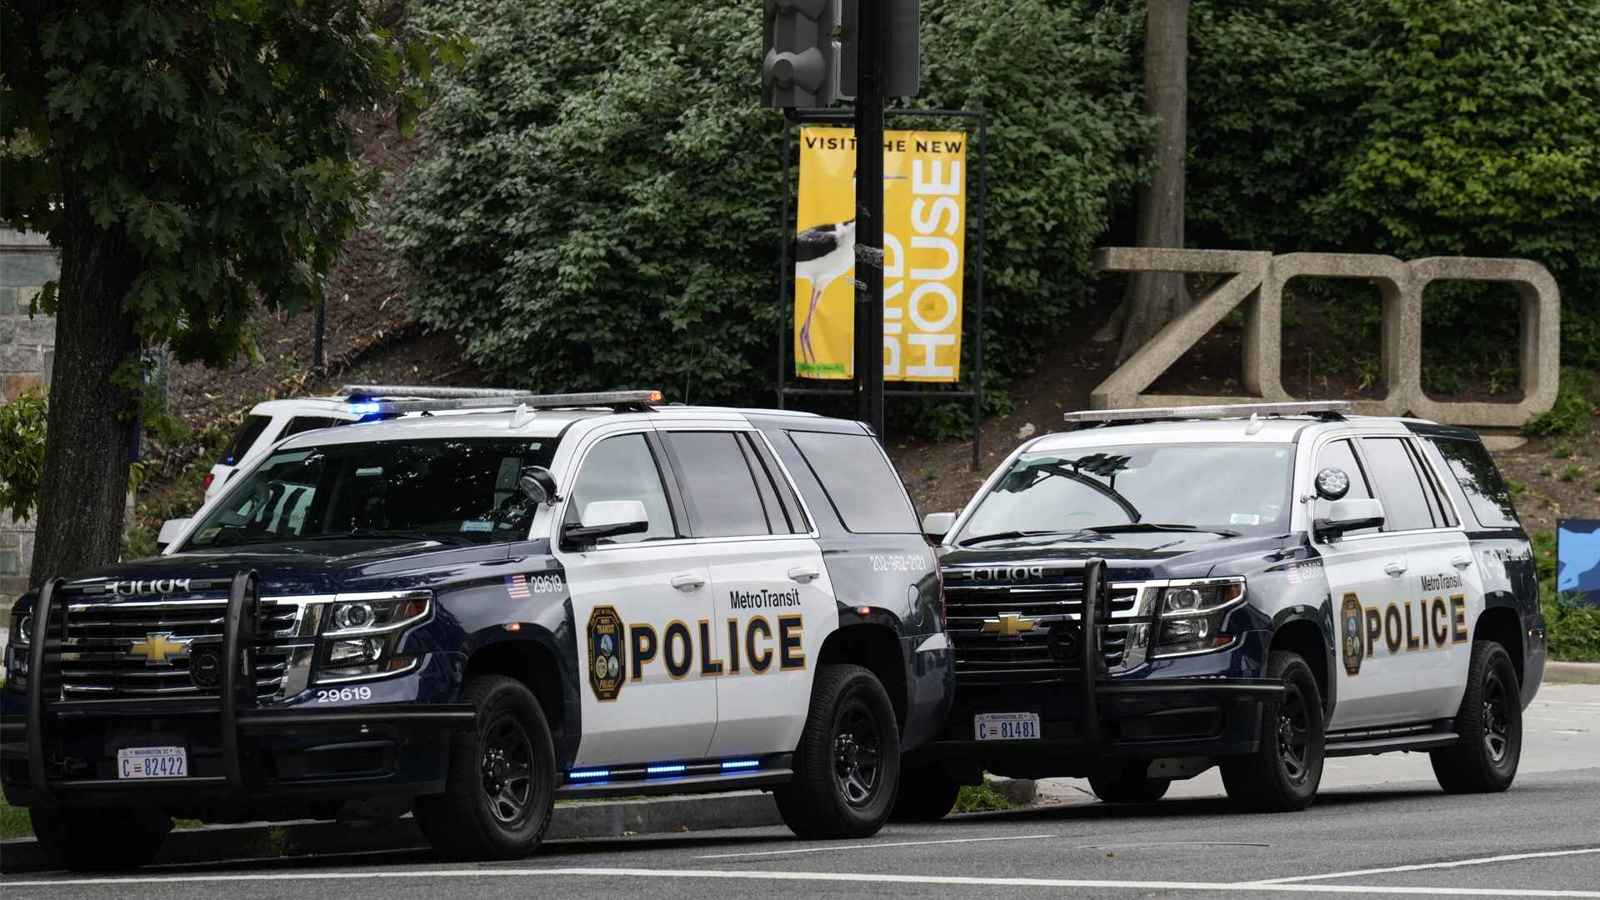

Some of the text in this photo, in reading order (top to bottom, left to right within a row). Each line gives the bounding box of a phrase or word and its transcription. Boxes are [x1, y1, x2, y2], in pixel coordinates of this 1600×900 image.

[805, 136, 962, 153] VISIT HE NEW
[906, 159, 961, 378] HOUSE
[1092, 246, 1561, 427] ZOO
[530, 574, 563, 593] 29619
[729, 588, 801, 609] MetroTransit
[1364, 593, 1469, 659] POLICE
[628, 613, 807, 683] POLICE
[317, 686, 372, 703] 29619
[1001, 720, 1035, 738] 81481
[144, 756, 184, 776] 82422
